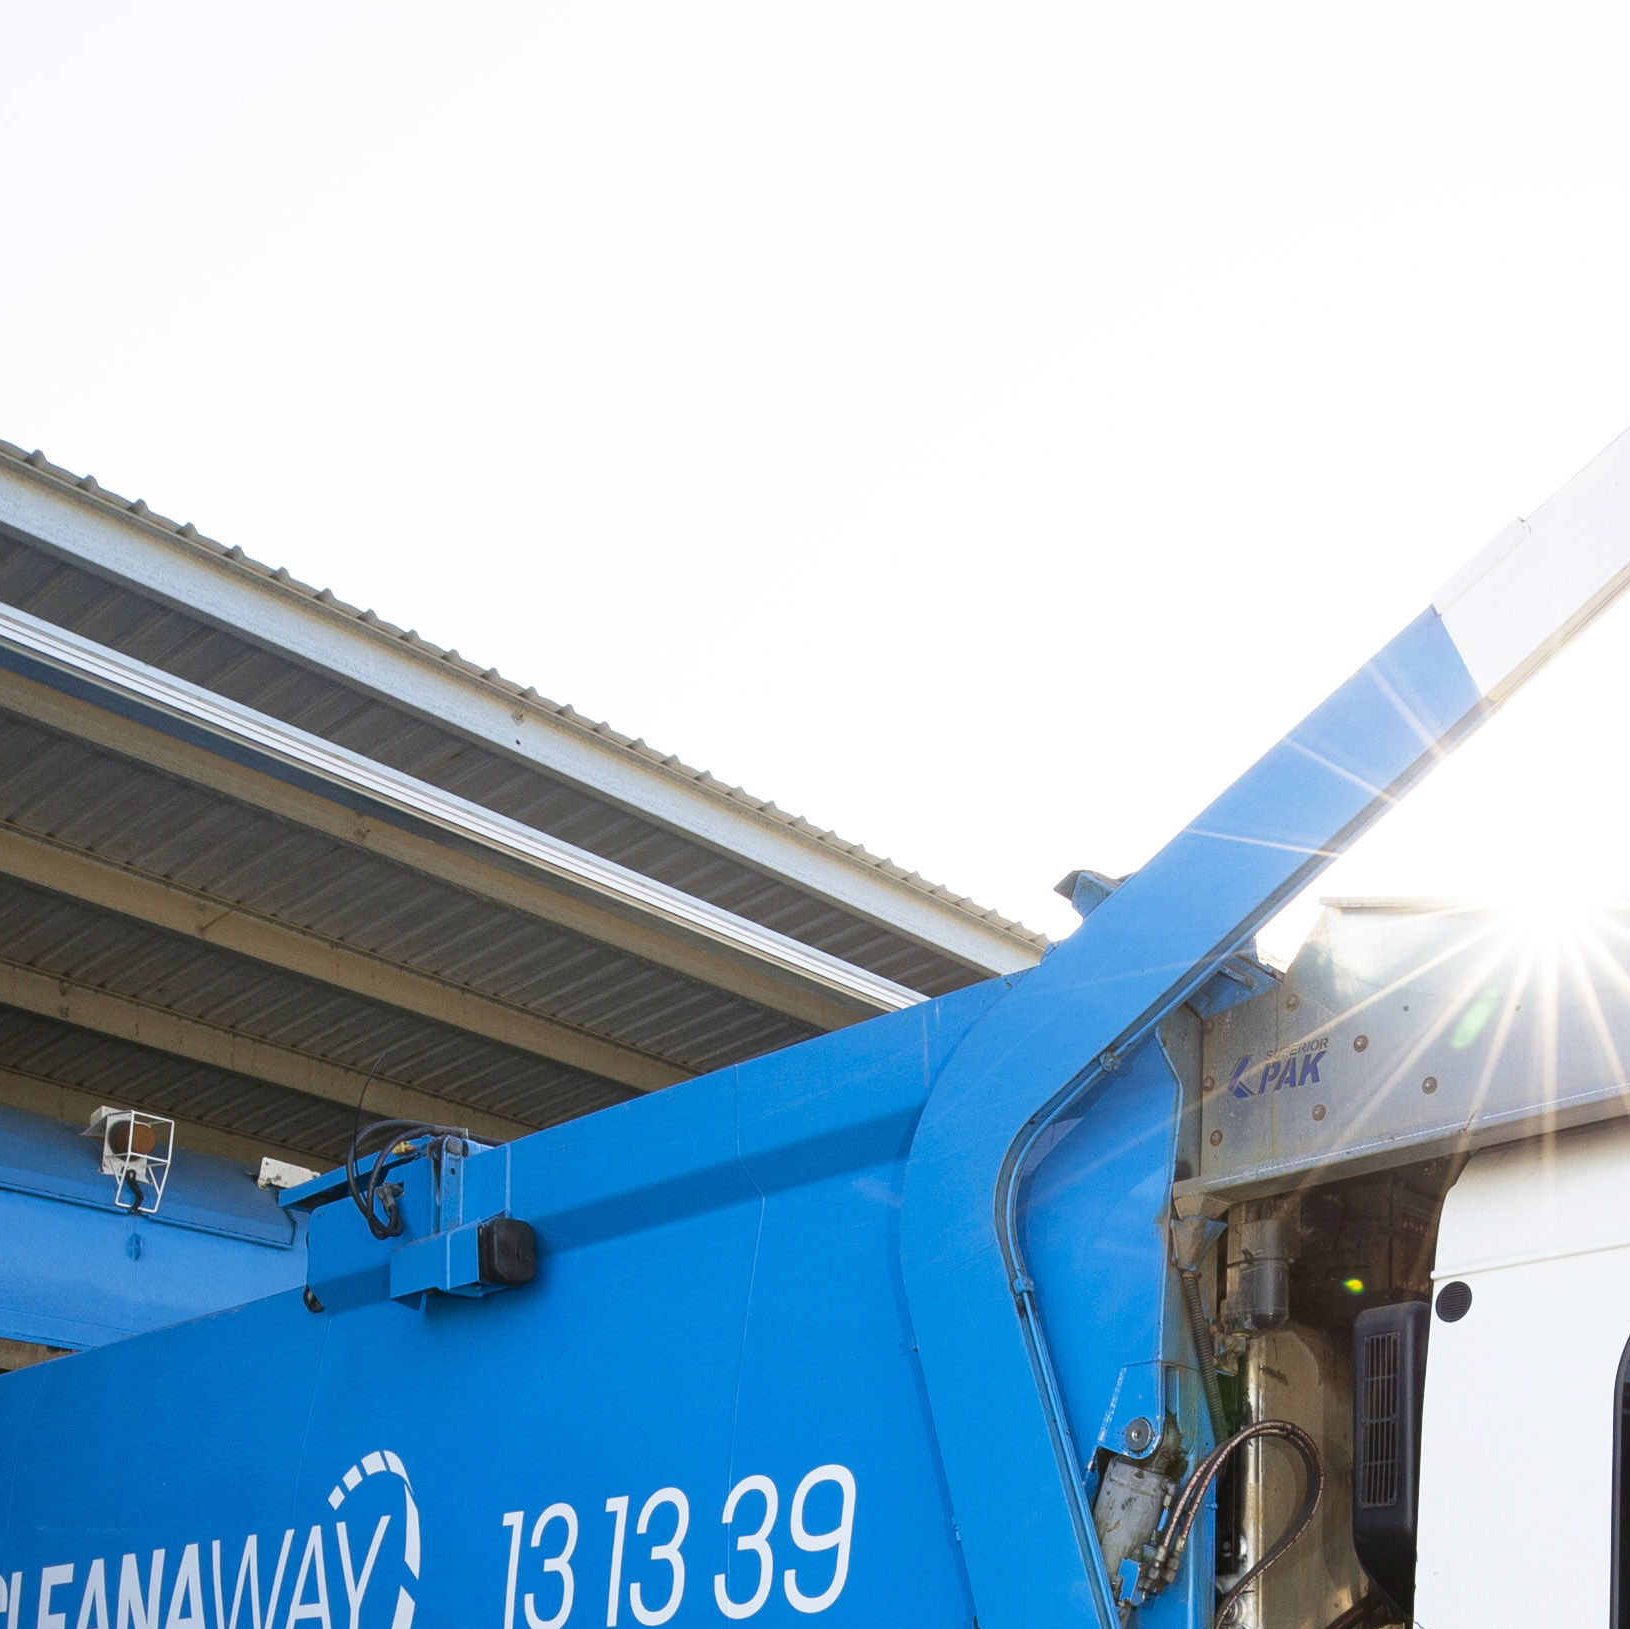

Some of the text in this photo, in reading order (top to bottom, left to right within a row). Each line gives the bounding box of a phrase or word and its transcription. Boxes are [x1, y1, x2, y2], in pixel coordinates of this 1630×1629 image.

[1265, 1038, 1329, 1060] SUPERIOR
[1258, 1051, 1327, 1094] PAK
[605, 1486, 689, 1628] 13
[714, 1463, 857, 1620] 39
